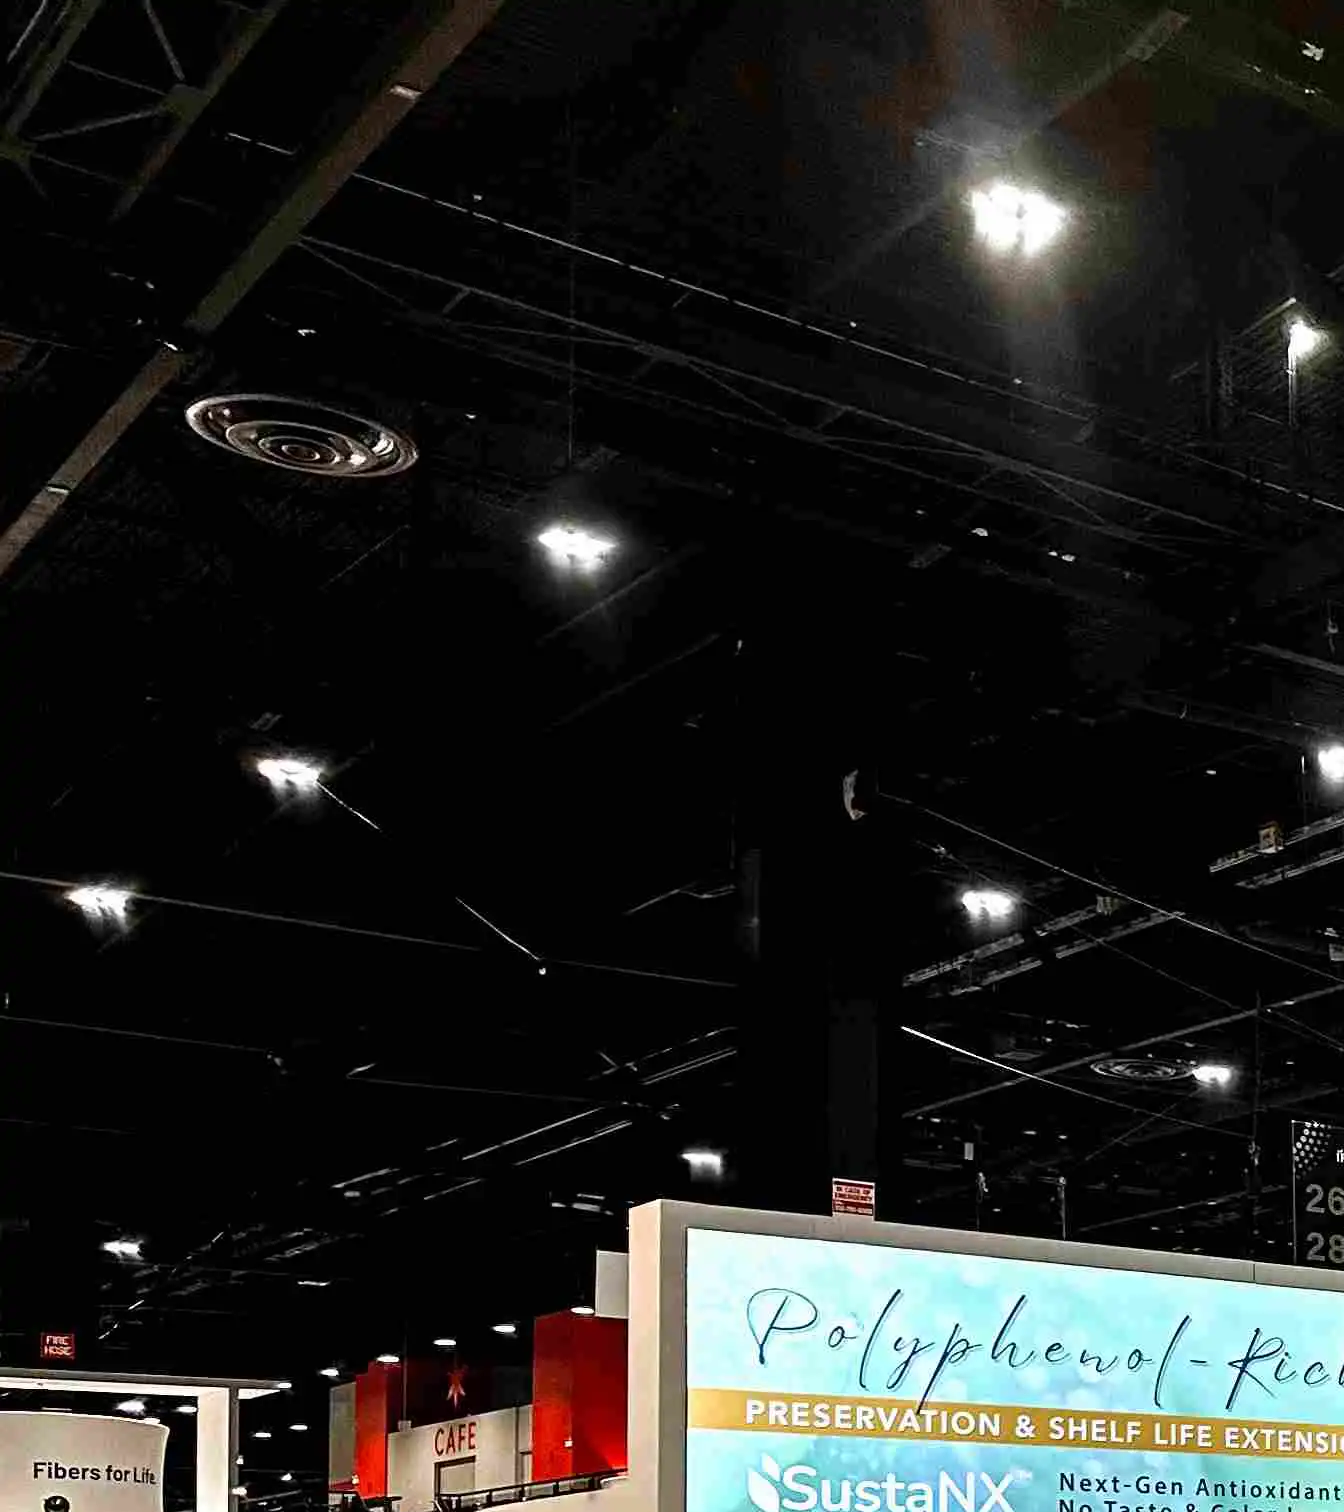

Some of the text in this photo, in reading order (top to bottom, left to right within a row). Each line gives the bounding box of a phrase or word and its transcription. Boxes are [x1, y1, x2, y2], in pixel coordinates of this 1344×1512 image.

[434, 1421, 477, 1457] CAFE
[745, 1399, 1001, 1437] PRESERVATION
[1015, 1416, 1036, 1440] &
[1049, 1417, 1142, 1444] SHELF
[1153, 1421, 1214, 1448] LIFE
[33, 1462, 156, 1484] Fibers for Life
[1059, 1473, 1341, 1501] Next-Gen Antioxidant
